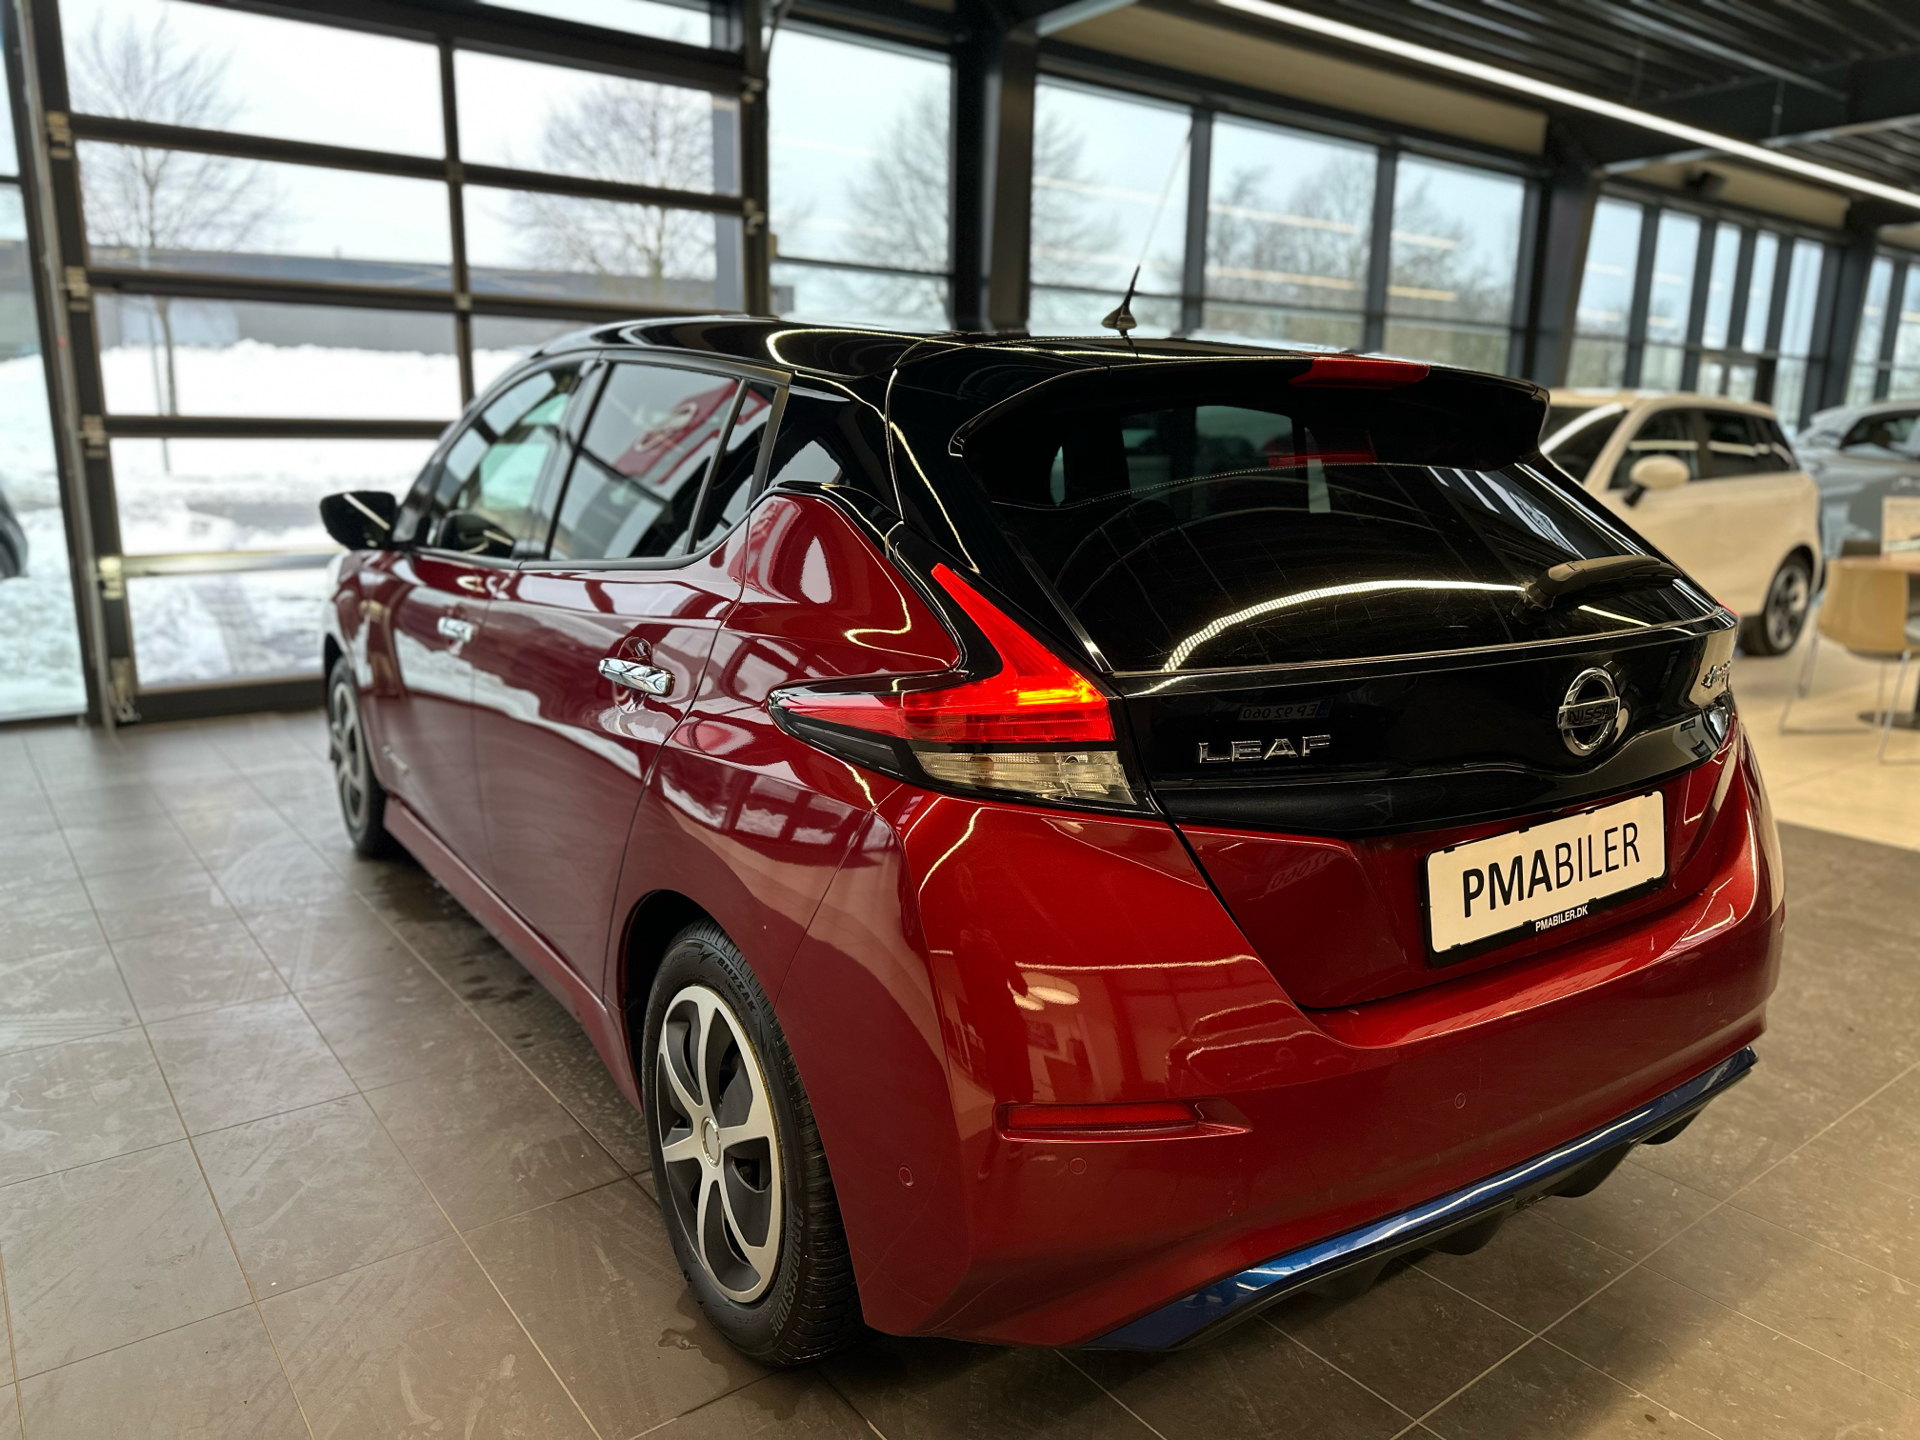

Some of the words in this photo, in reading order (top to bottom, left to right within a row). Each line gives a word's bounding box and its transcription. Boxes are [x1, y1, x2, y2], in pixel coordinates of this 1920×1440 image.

[1566, 702, 1617, 725] NISSAN
[1197, 734, 1331, 764] LEAF
[1462, 821, 1640, 918] PMABILER
[1535, 904, 1588, 932] PMABILER.DK
[716, 957, 757, 1012] BLIZZAK
